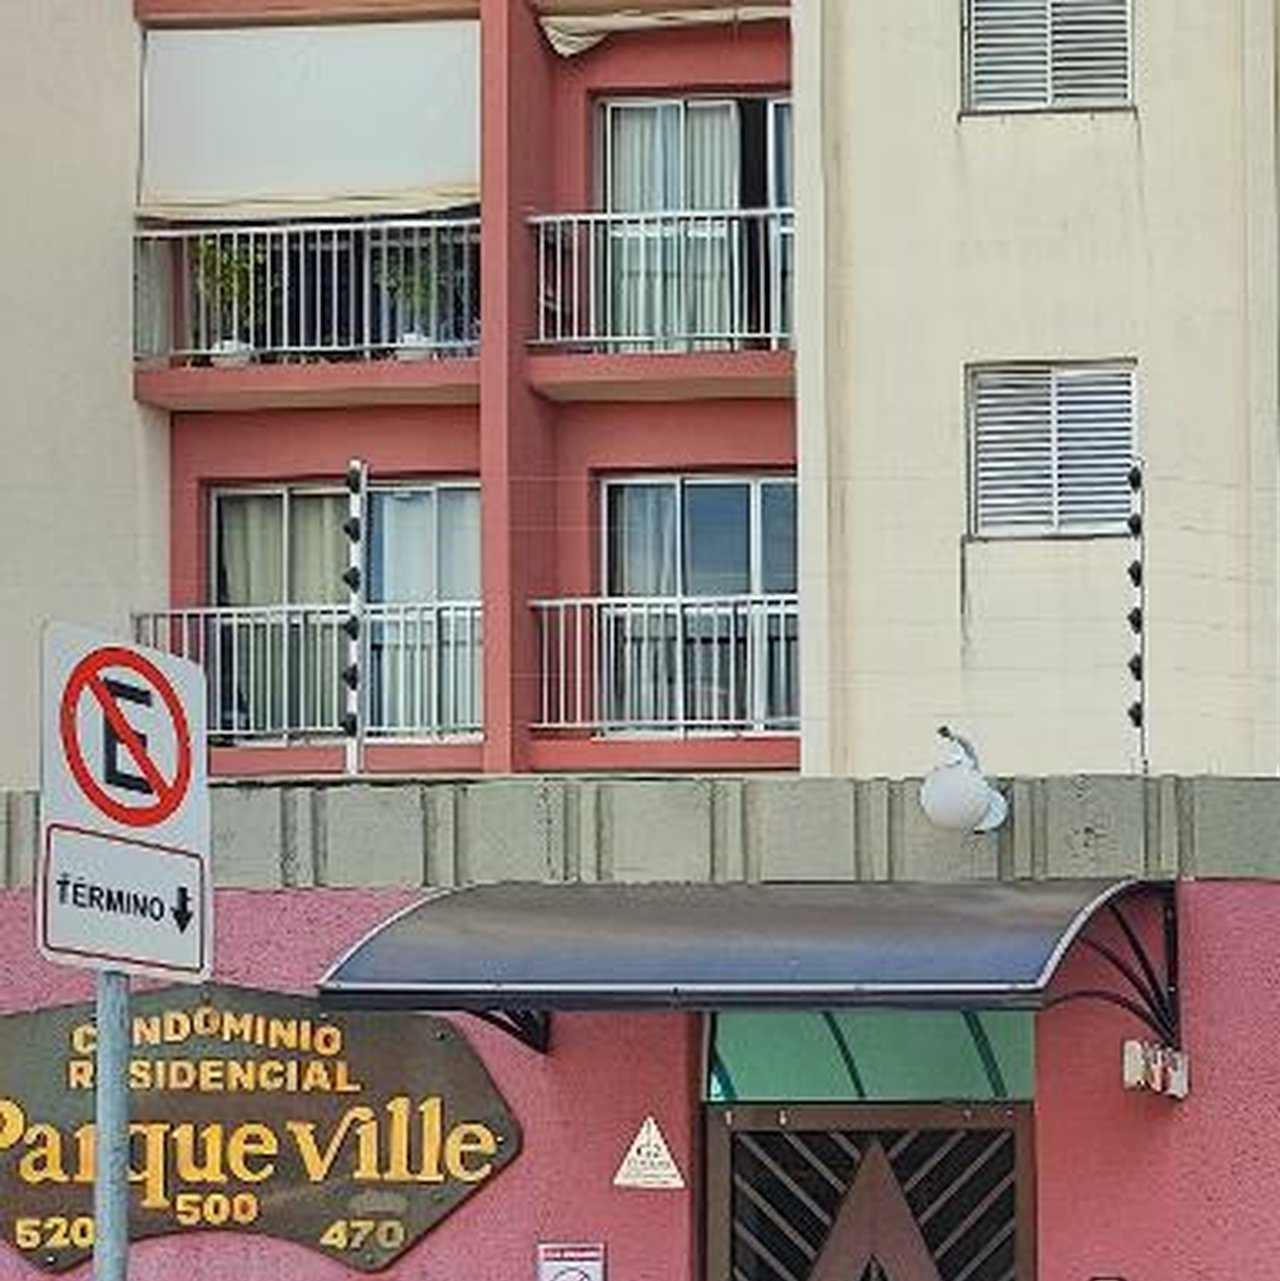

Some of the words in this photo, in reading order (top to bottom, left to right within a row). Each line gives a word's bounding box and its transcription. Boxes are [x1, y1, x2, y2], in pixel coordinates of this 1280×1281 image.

[72, 1004, 342, 1056] CNDOMINIO
[69, 1059, 360, 1092] RSIDENCIAL
[16, 1216, 95, 1249] 520
[176, 1193, 257, 1225] 500
[320, 1219, 404, 1249] 470
